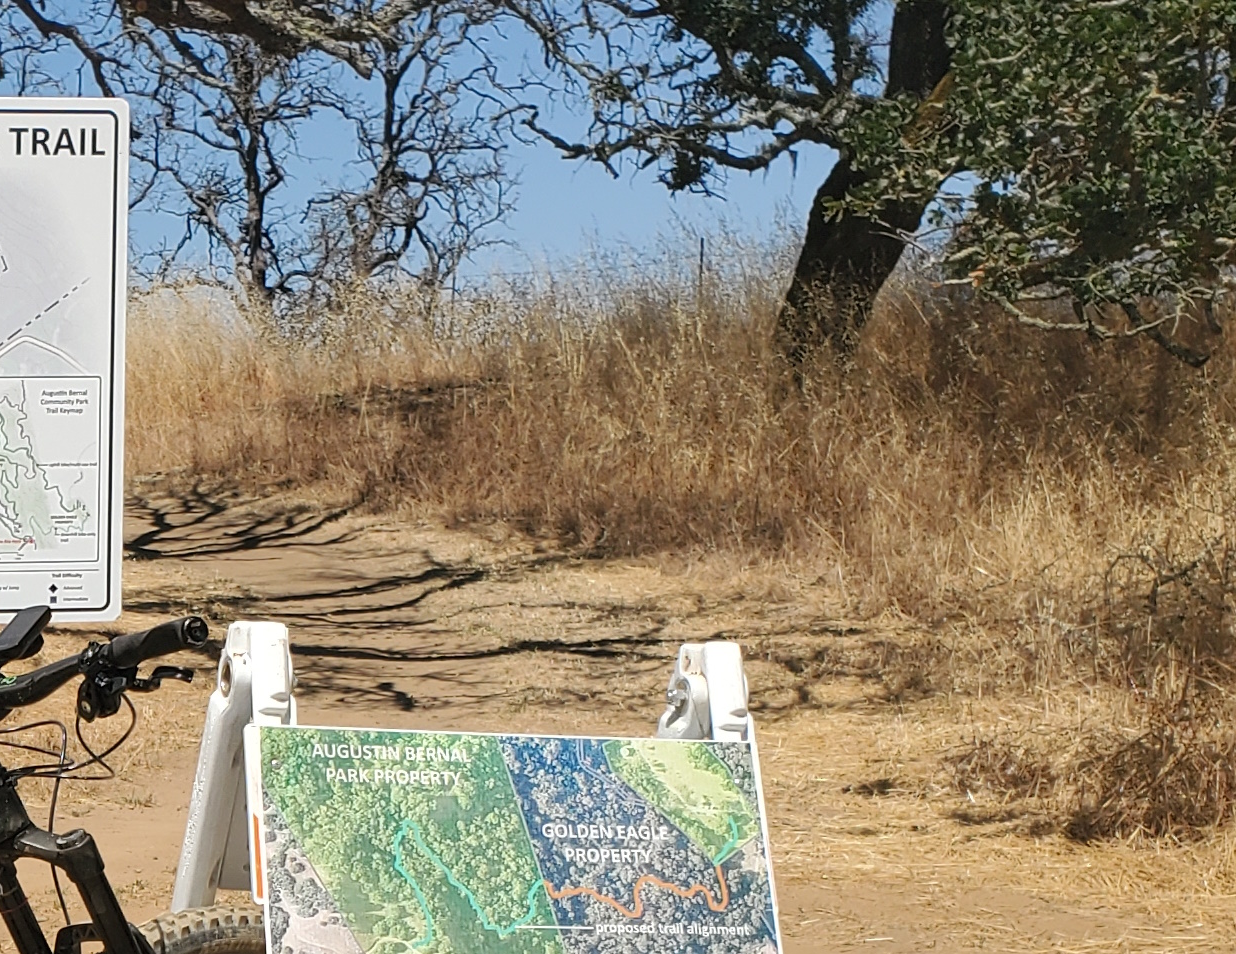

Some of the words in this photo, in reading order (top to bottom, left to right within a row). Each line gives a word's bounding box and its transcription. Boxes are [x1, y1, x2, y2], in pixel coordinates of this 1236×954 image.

[8, 127, 105, 156] TRAIL
[42, 390, 67, 398] Augustin
[312, 743, 400, 761] AUGUSTIN
[405, 747, 472, 763] BERNAL
[326, 768, 370, 783] PARK
[374, 770, 461, 786] PROPERTY
[542, 823, 614, 839] GOLDEN
[617, 825, 669, 841] EAGLE
[565, 848, 652, 864] PROPERTY
[596, 922, 654, 936] proposed
[658, 922, 684, 935] trail
[687, 922, 750, 937] alignment
